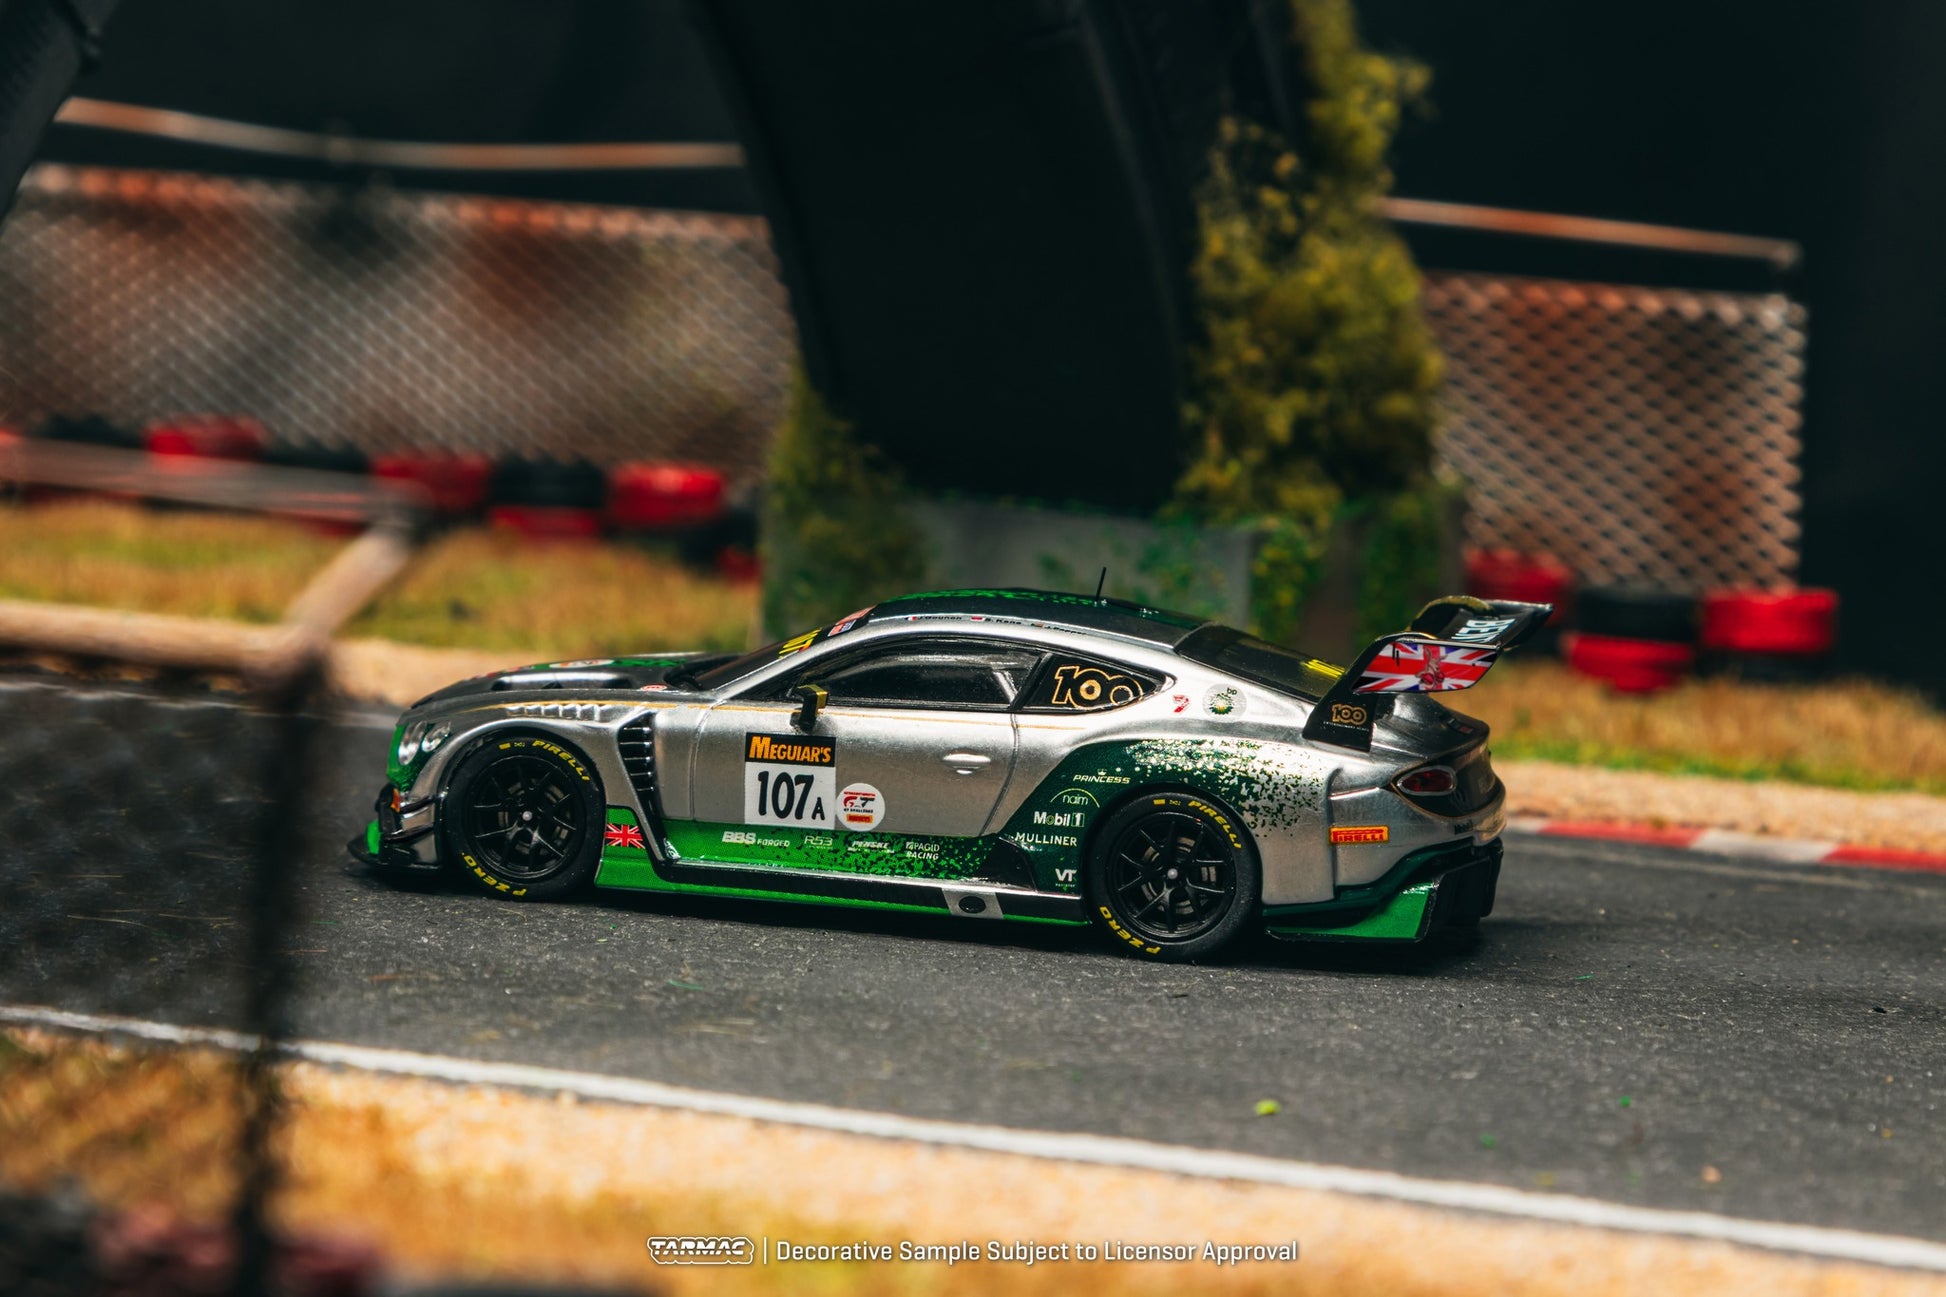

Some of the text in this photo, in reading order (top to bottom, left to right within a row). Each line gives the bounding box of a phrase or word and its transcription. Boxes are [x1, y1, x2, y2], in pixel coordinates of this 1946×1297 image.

[1052, 665, 1144, 710] 100
[1331, 703, 1368, 726] 100
[749, 735, 832, 763] MEGUIAR'S
[532, 739, 591, 781] PIRELLI
[1073, 774, 1131, 785] PRINCESS
[1062, 793, 1089, 806] naim
[1188, 800, 1242, 849] PIRELLI
[722, 831, 757, 845] BBS
[757, 838, 791, 848] FORGED
[914, 842, 940, 853] PAGID
[1015, 832, 1078, 847] MULLINER
[906, 851, 939, 860] RACING
[1055, 868, 1078, 882] VT
